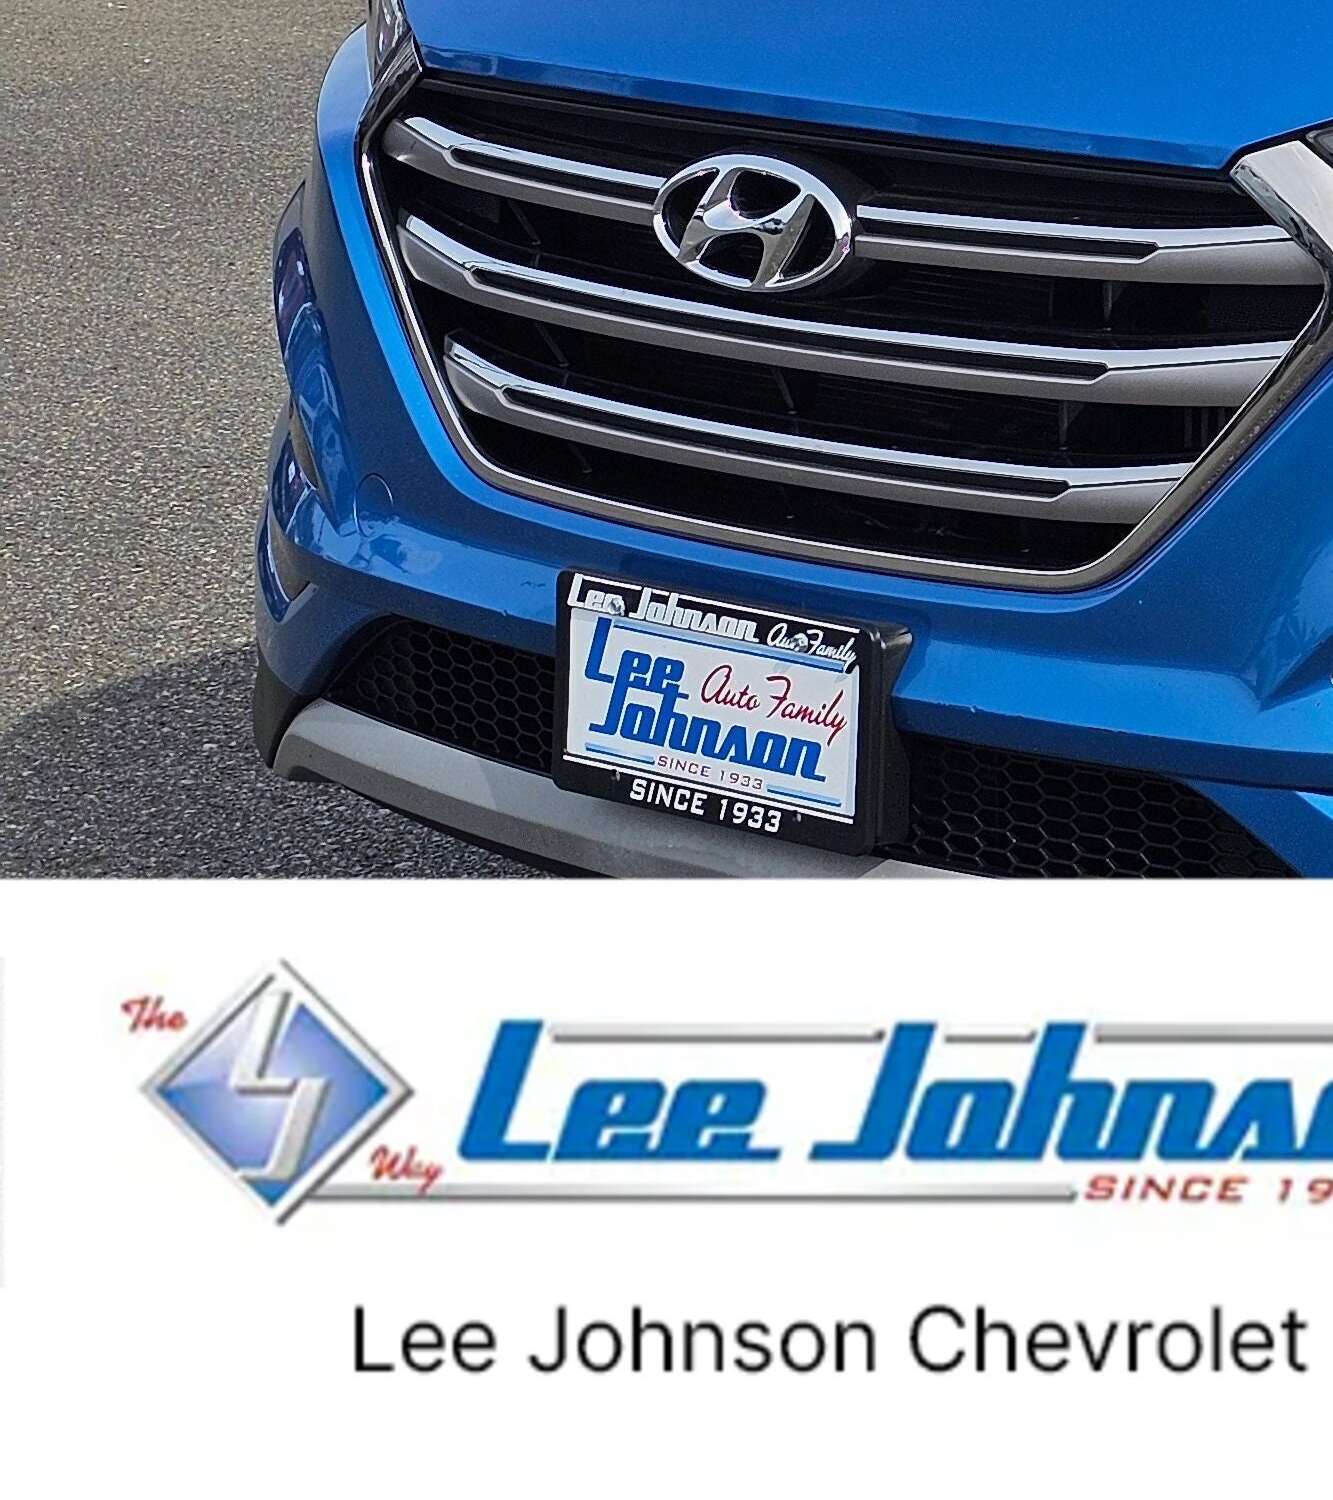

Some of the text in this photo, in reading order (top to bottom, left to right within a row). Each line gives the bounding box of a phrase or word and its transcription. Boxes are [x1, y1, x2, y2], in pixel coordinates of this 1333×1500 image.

[629, 586, 760, 644] Johnson
[767, 622, 808, 652] Au
[804, 629, 857, 675] Family
[584, 616, 848, 747] Lee Auto Family
[588, 680, 827, 783] Johnson
[656, 755, 764, 791] SINCE 1933
[629, 778, 783, 834] SINCE 1933
